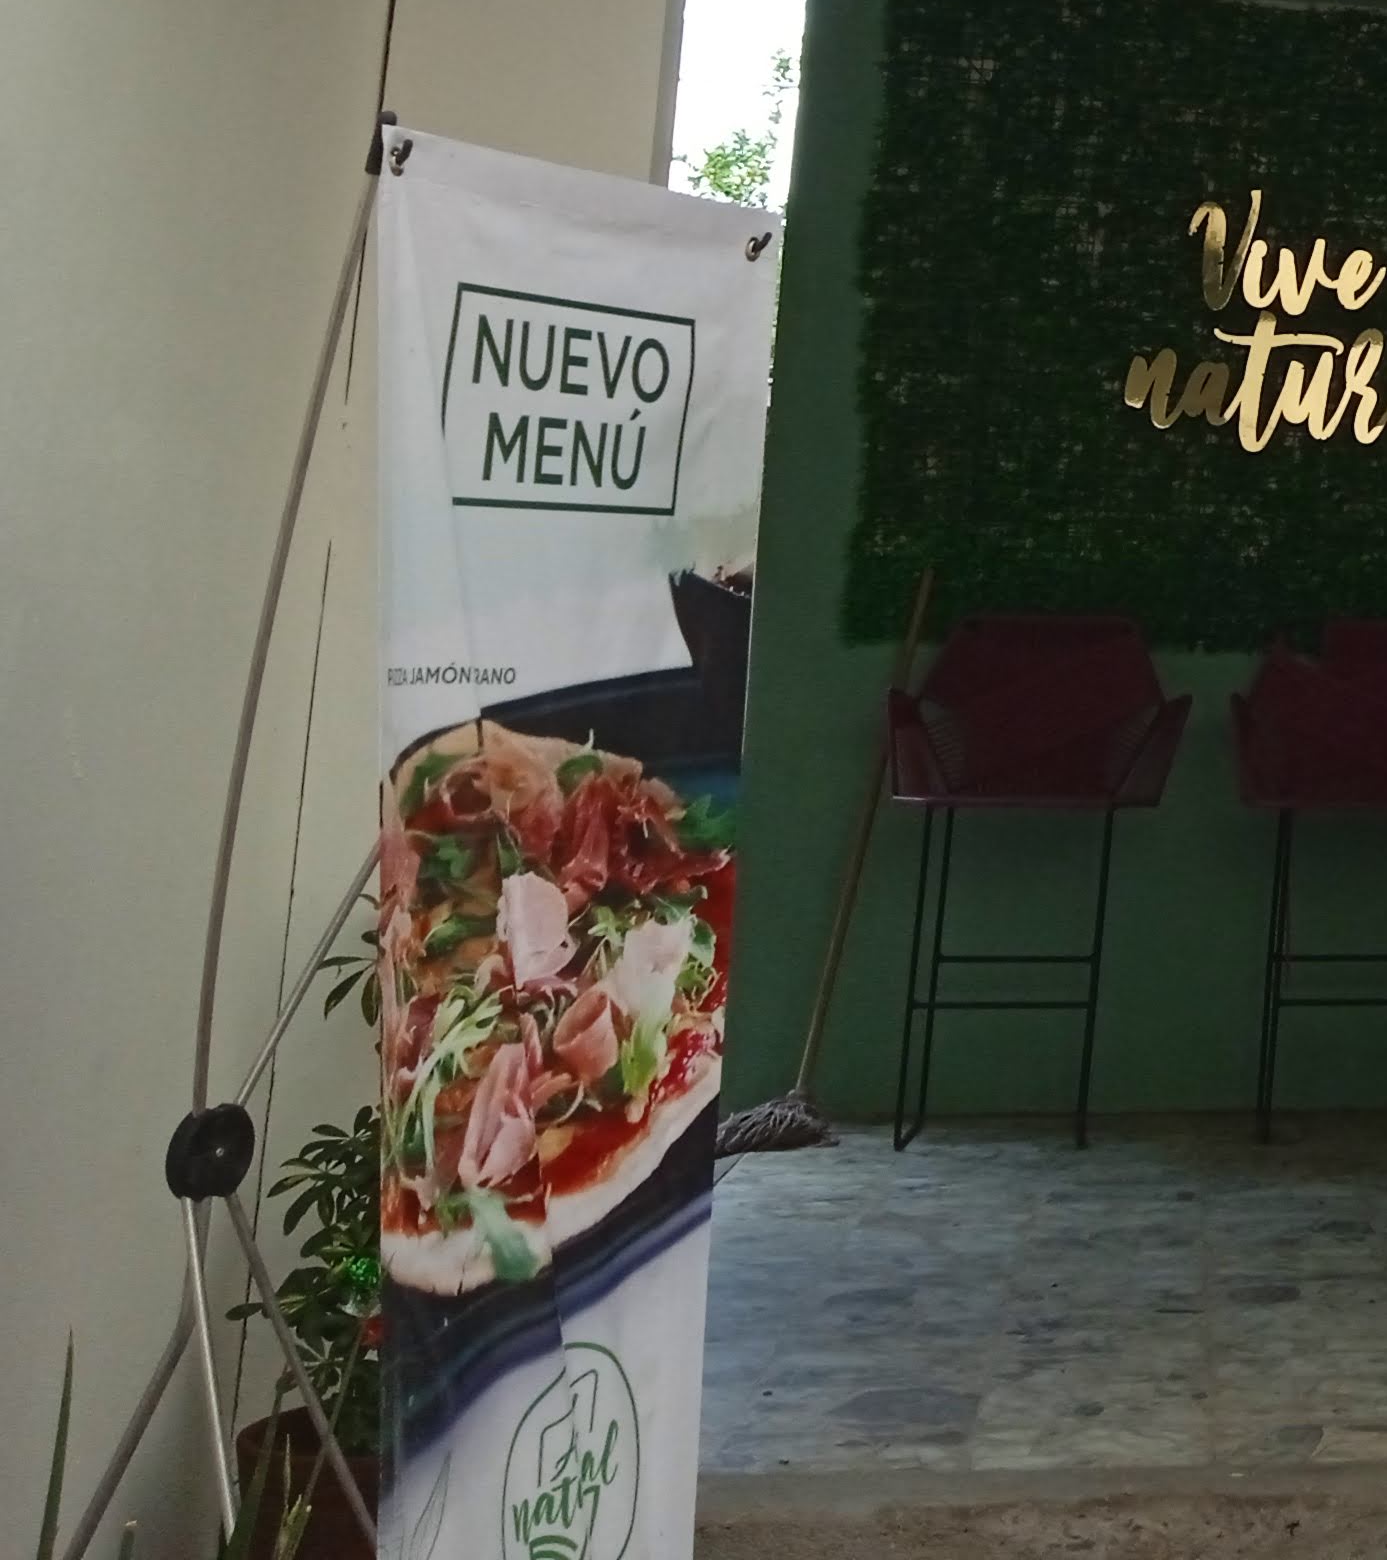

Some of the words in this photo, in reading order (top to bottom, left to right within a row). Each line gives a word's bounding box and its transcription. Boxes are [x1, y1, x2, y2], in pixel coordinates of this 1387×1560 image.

[1188, 189, 1387, 315] Vive
[472, 314, 670, 403] NUEVO
[482, 409, 646, 490] MENÚ
[410, 662, 472, 685] JAMÓN
